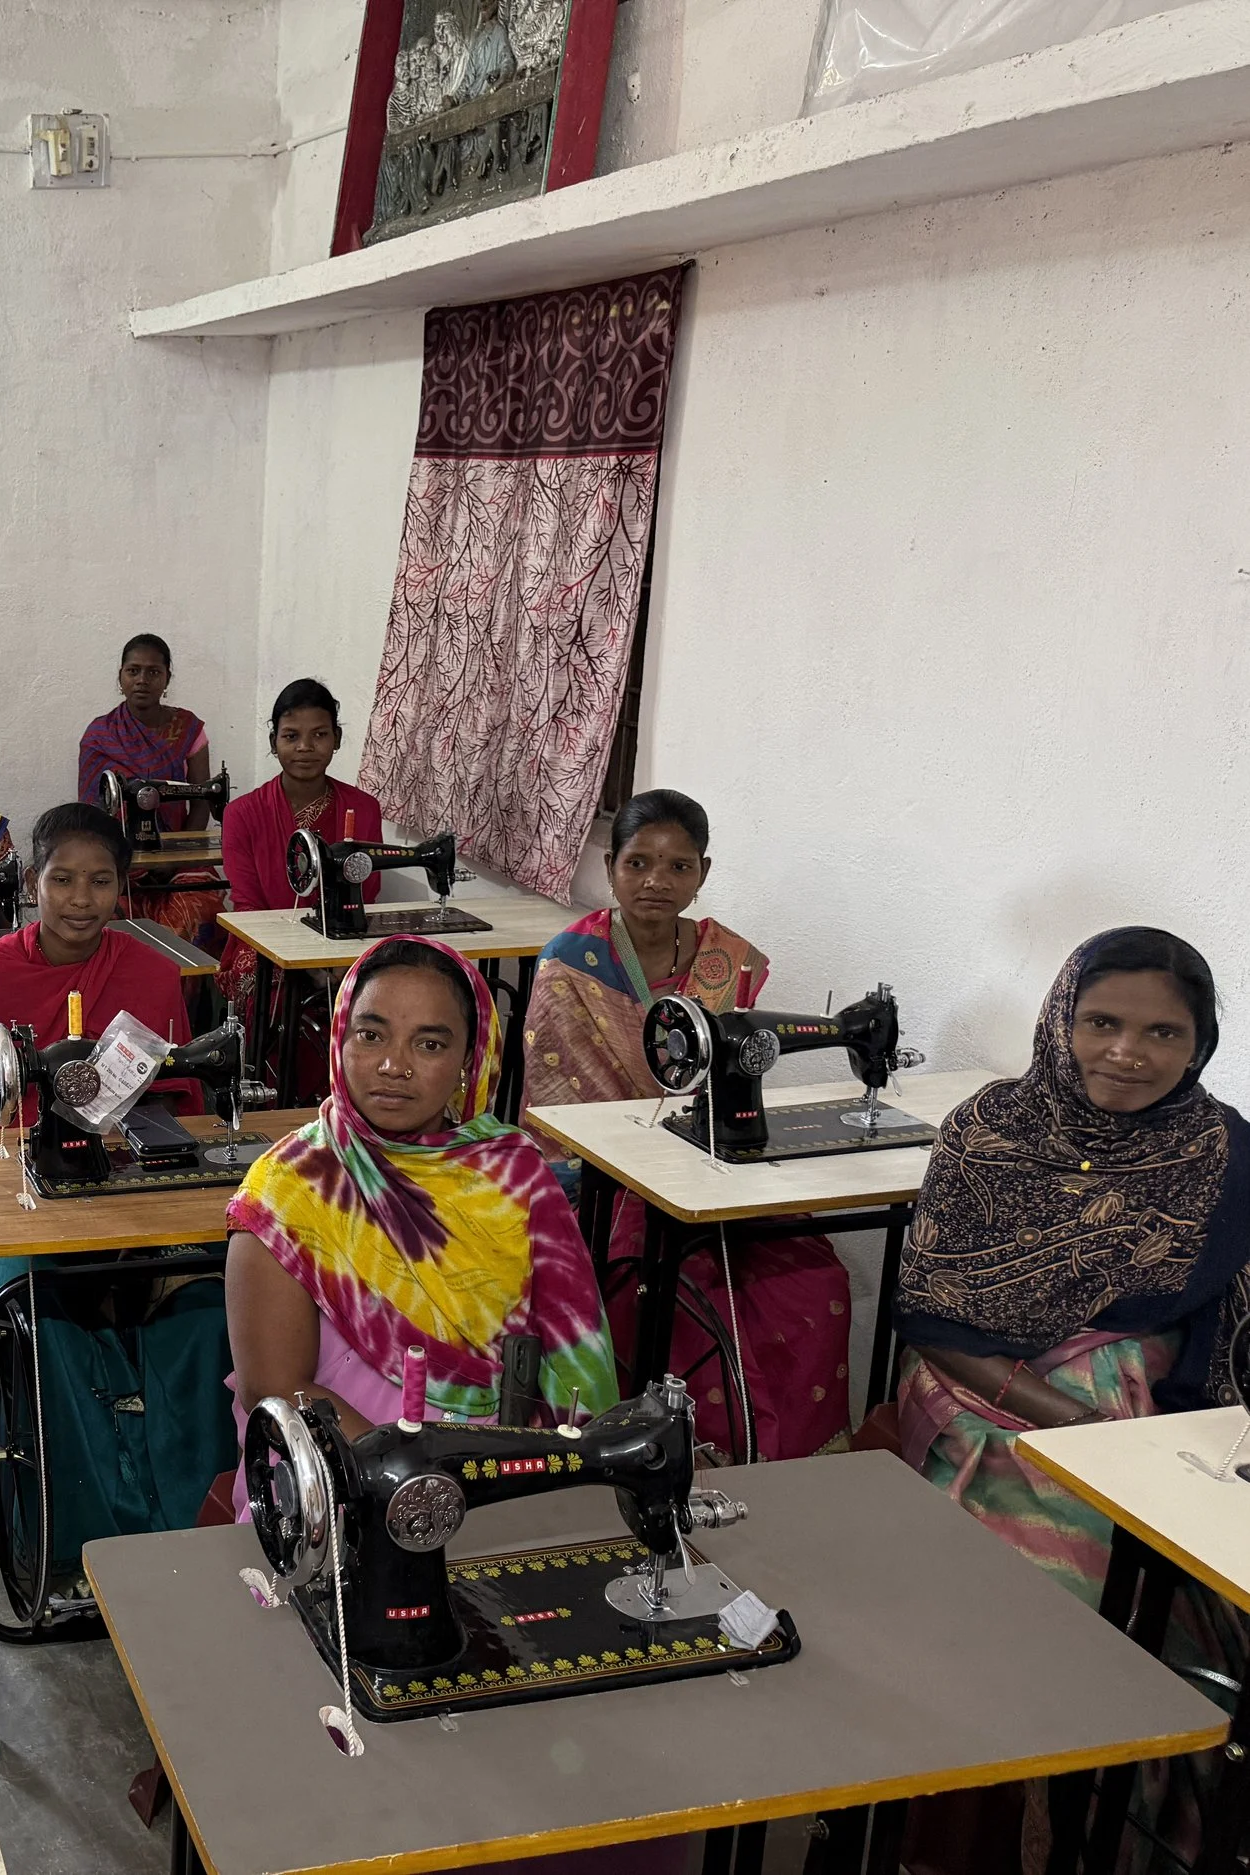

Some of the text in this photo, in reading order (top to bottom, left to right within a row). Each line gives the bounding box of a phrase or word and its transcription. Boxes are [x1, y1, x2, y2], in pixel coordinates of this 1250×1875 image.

[502, 1459, 544, 1473] USHA
[387, 1606, 429, 1618] USHA
[516, 1611, 557, 1623] USHA
